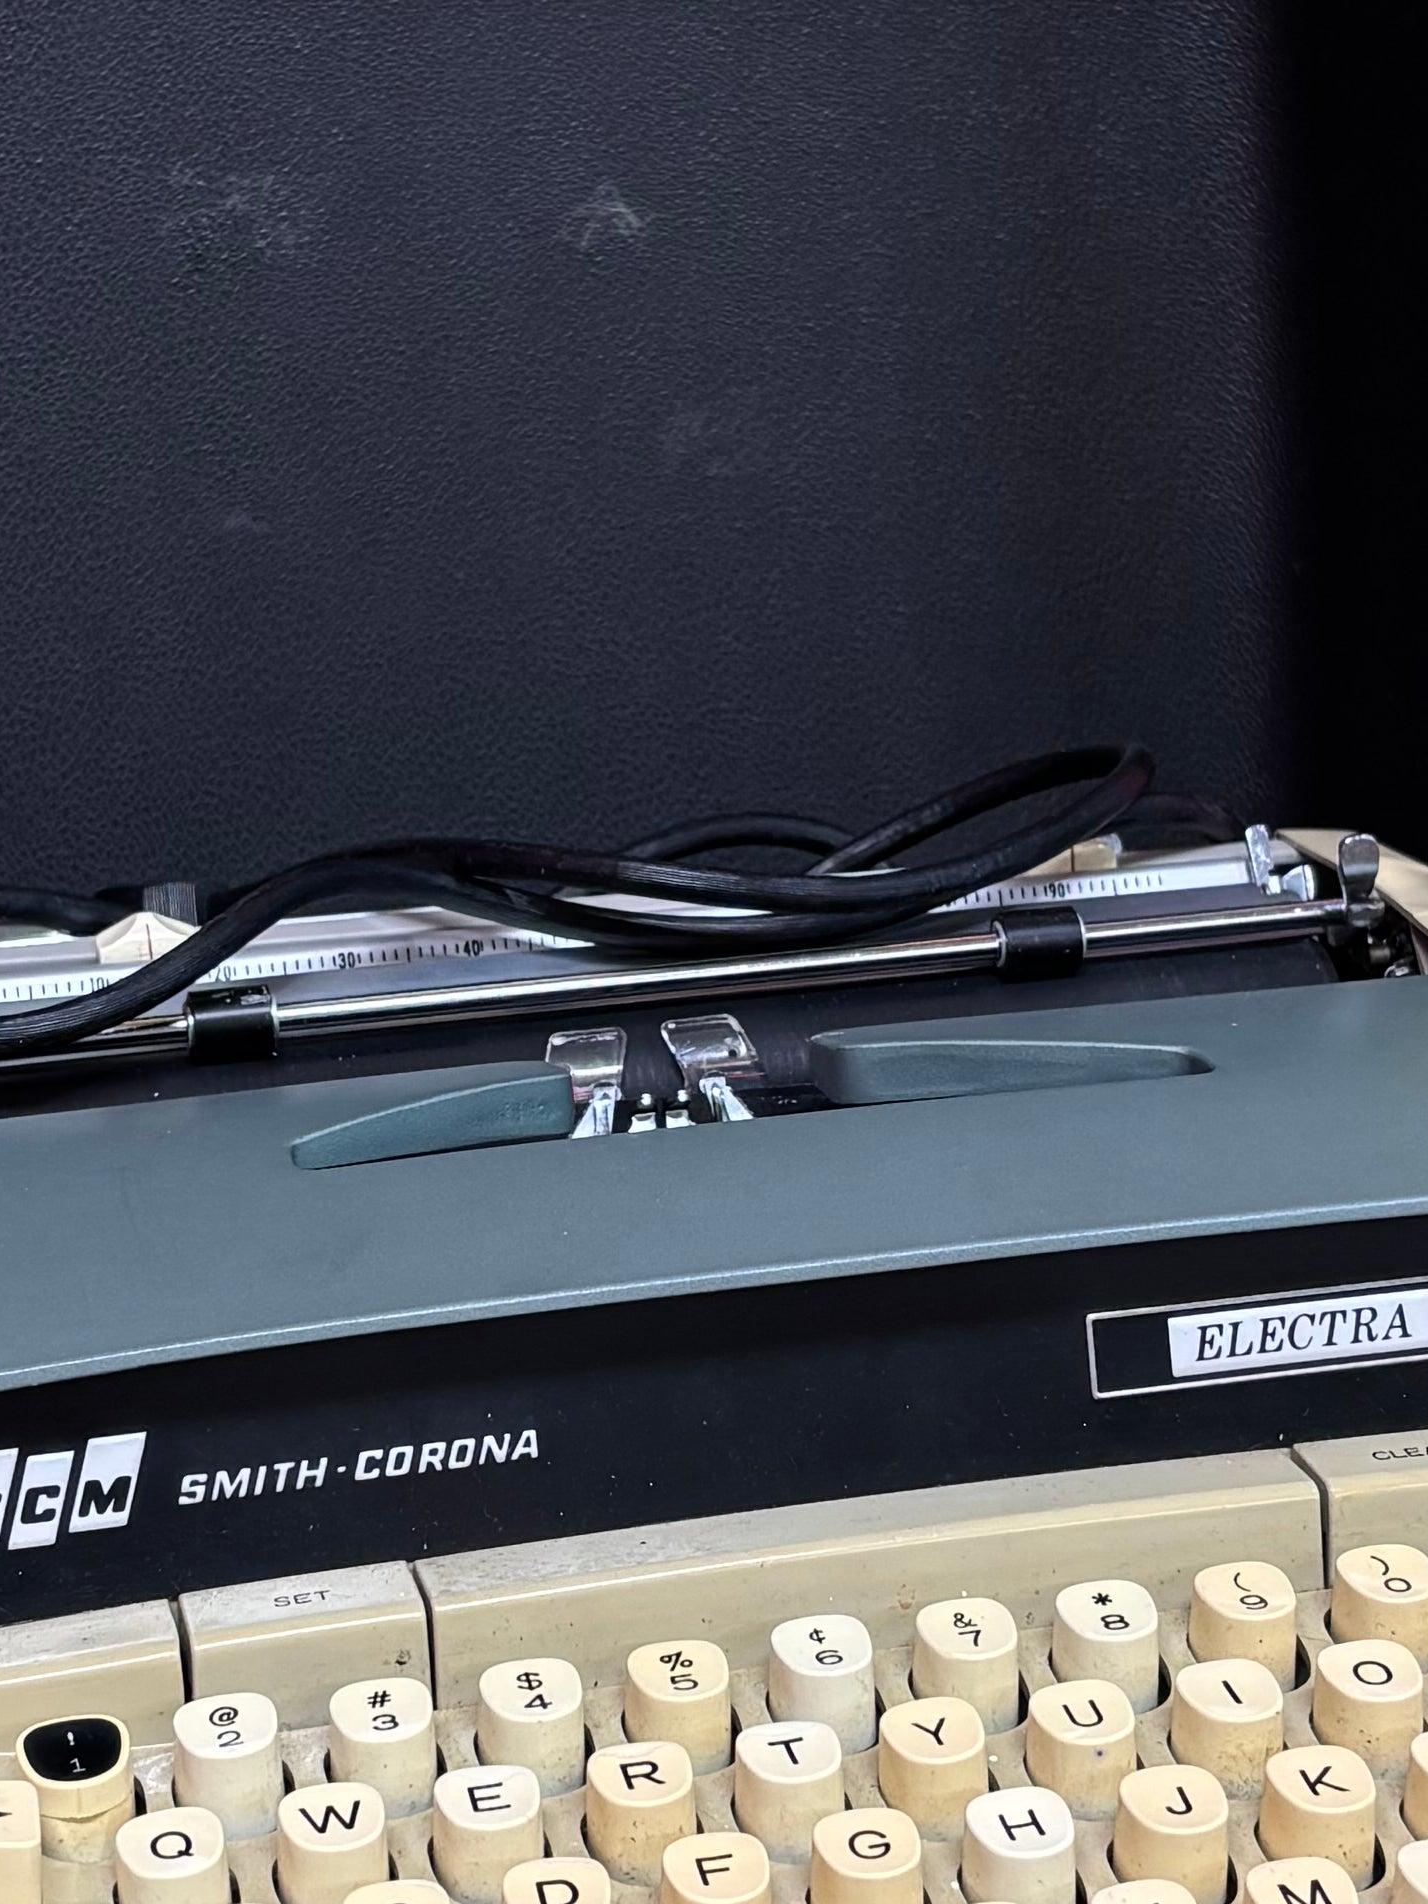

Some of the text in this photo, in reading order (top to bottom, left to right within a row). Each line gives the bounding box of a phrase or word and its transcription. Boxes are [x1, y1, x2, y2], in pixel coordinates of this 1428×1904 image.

[463, 940, 480, 956] 40
[338, 954, 355, 969] 30
[1194, 1303, 1413, 1363] ELECTRA
[1233, 1571, 1251, 1593] (
[273, 1589, 330, 1608] SET
[1239, 1594, 1269, 1611] 9
[953, 1612, 979, 1629] &
[1100, 1614, 1131, 1631] 8
[957, 1629, 982, 1647] 7
[659, 1650, 694, 1672] %
[814, 1649, 844, 1666] 6
[516, 1671, 543, 1692] $
[669, 1673, 699, 1691] 5
[1352, 1660, 1394, 1686] O
[367, 1690, 392, 1709] #
[524, 1693, 553, 1710] 4
[1221, 1680, 1243, 1705] I
[208, 1706, 239, 1727] @
[371, 1713, 400, 1731] 3
[1062, 1699, 1104, 1728] U
[216, 1730, 244, 1748] 2
[911, 1717, 946, 1746] Y
[767, 1736, 804, 1765] T
[69, 1757, 87, 1773] 1
[619, 1760, 666, 1791] R
[1299, 1765, 1350, 1797] K
[467, 1781, 512, 1813] E
[1165, 1786, 1193, 1816] J
[298, 1799, 361, 1834] W
[998, 1808, 1047, 1842] H
[149, 1830, 194, 1860] Q
[848, 1829, 892, 1860] G
[695, 1853, 733, 1887] F
